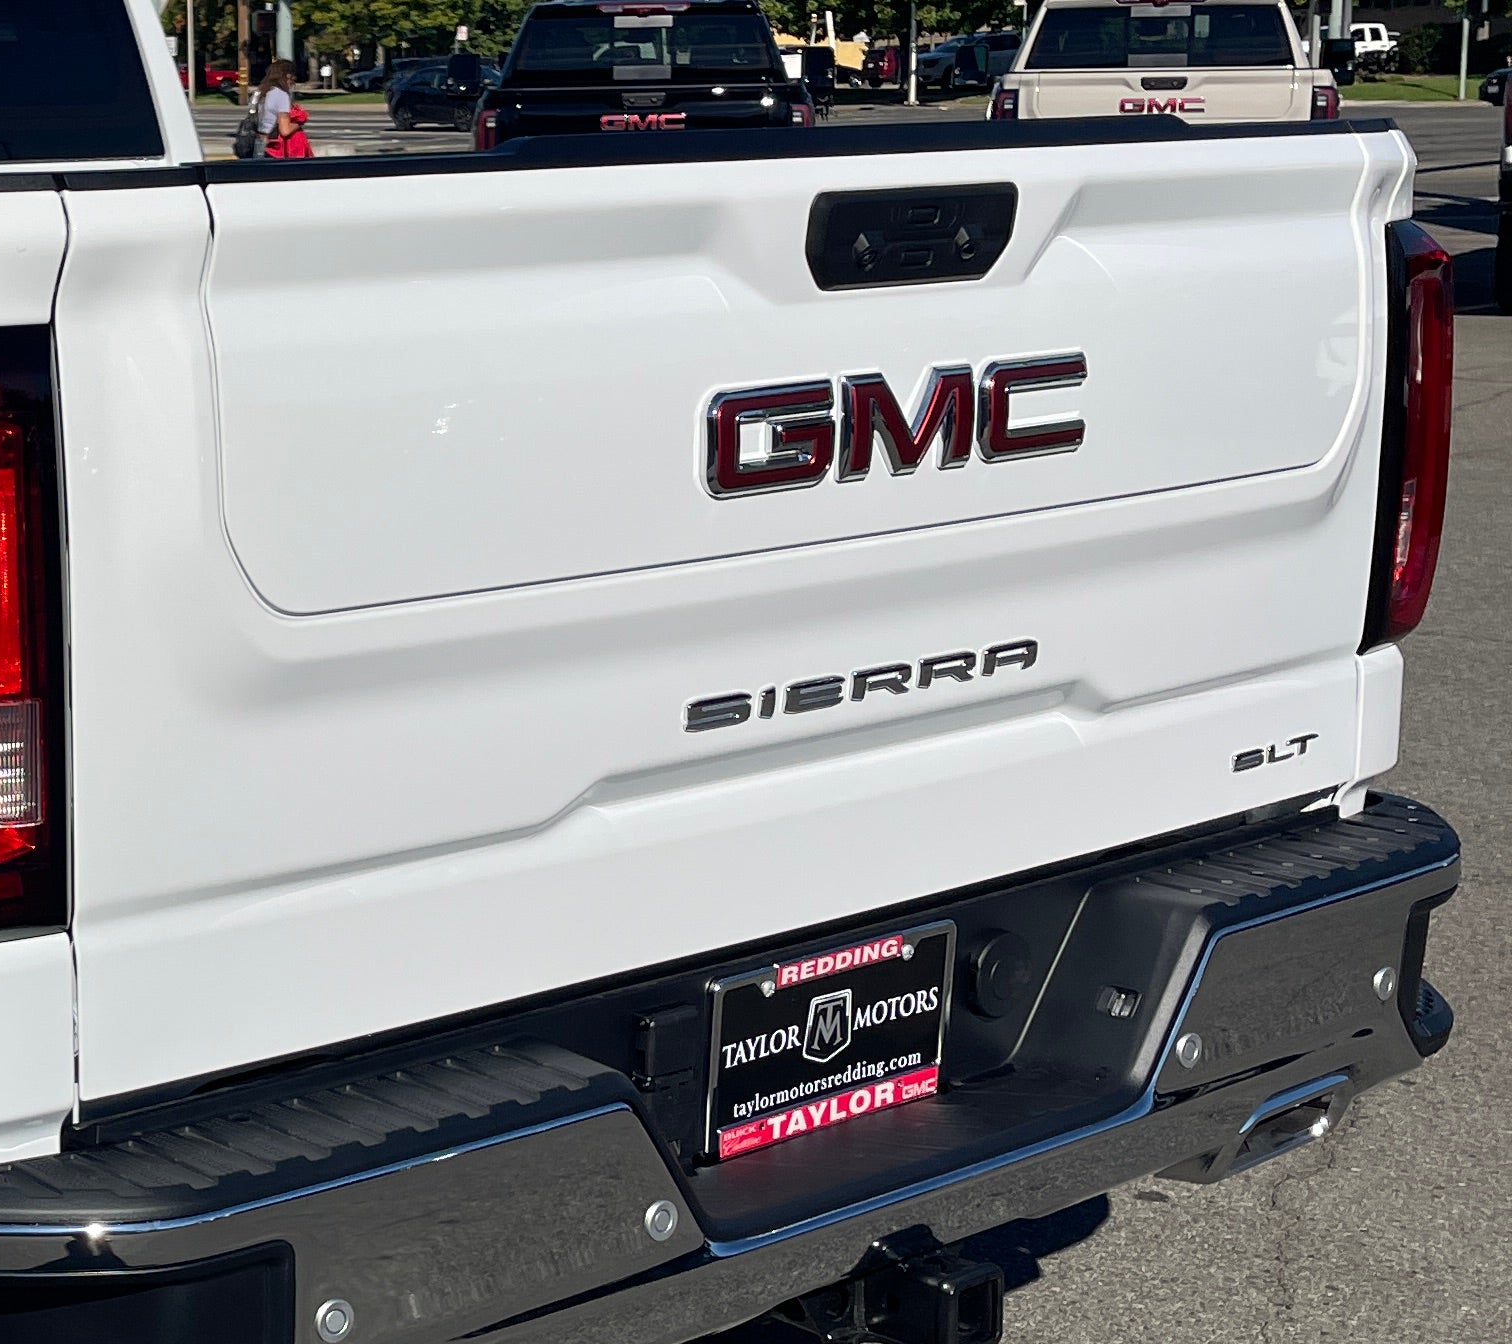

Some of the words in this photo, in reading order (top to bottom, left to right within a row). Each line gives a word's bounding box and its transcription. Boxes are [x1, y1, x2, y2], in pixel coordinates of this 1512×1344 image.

[599, 112, 688, 132] GMC
[1119, 95, 1206, 114] GMC
[698, 348, 1088, 501] GMC
[683, 637, 1041, 734] SIERRA
[1230, 732, 1320, 774] SLT
[780, 938, 901, 987] REDDING
[721, 1024, 802, 1070] TAYLOR
[852, 986, 939, 1031] MOTORS
[732, 1051, 922, 1119] taylormotorsredding.com
[766, 1081, 896, 1141] TAYLOR
[901, 1077, 937, 1101] GMC
